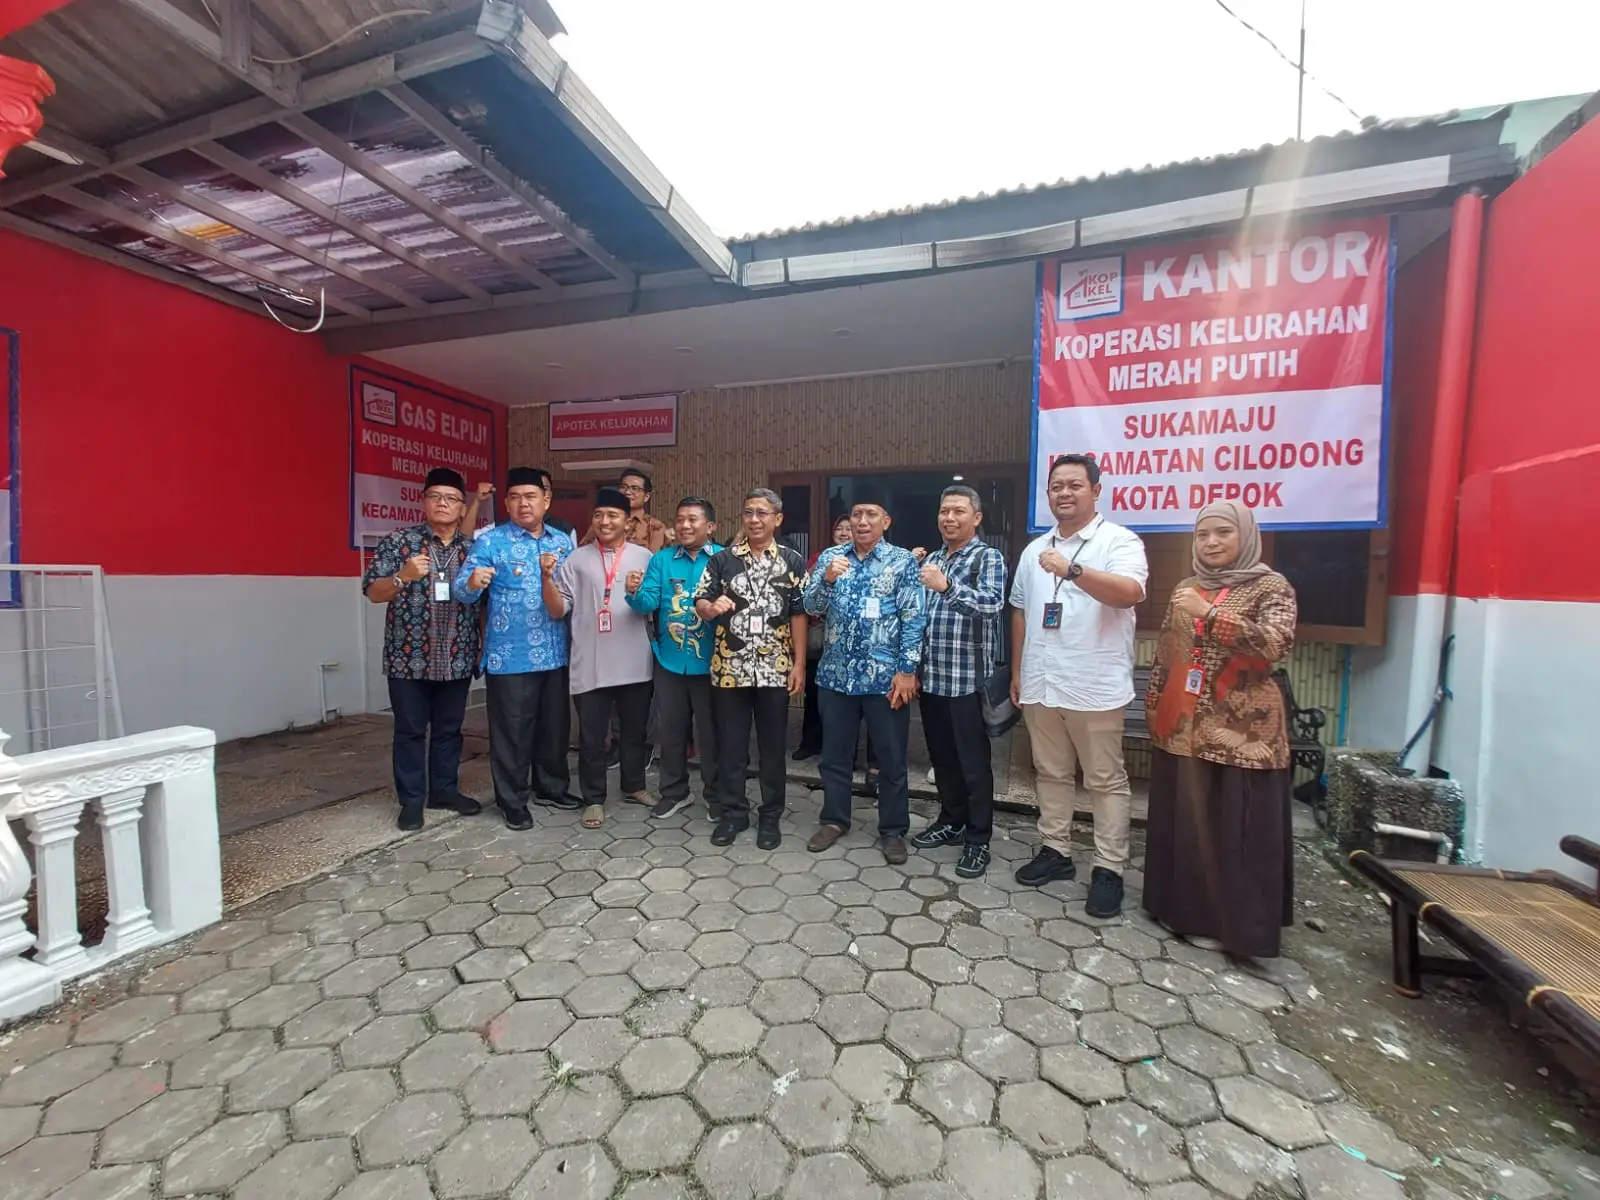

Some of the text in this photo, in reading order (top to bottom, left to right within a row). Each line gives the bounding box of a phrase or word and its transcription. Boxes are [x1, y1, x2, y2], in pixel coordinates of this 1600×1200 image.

[1088, 272, 1118, 284] KOP
[1142, 231, 1369, 301] KANTOR
[1088, 284, 1112, 296] KEL
[1054, 304, 1368, 361] KOPERASI KELURAHAN
[1109, 349, 1299, 392] MERAH PUTIH
[401, 401, 436, 432] GAS
[556, 415, 668, 432] APOTEK KELURAHAN
[1124, 405, 1276, 439] SUKAMAJU
[362, 428, 488, 471] KOPERASI KELURAHAN
[1048, 439, 1364, 476] AMATAN CILODONG
[1112, 482, 1284, 511] KOTA DEPOK
[362, 503, 427, 523] KECAMATA
